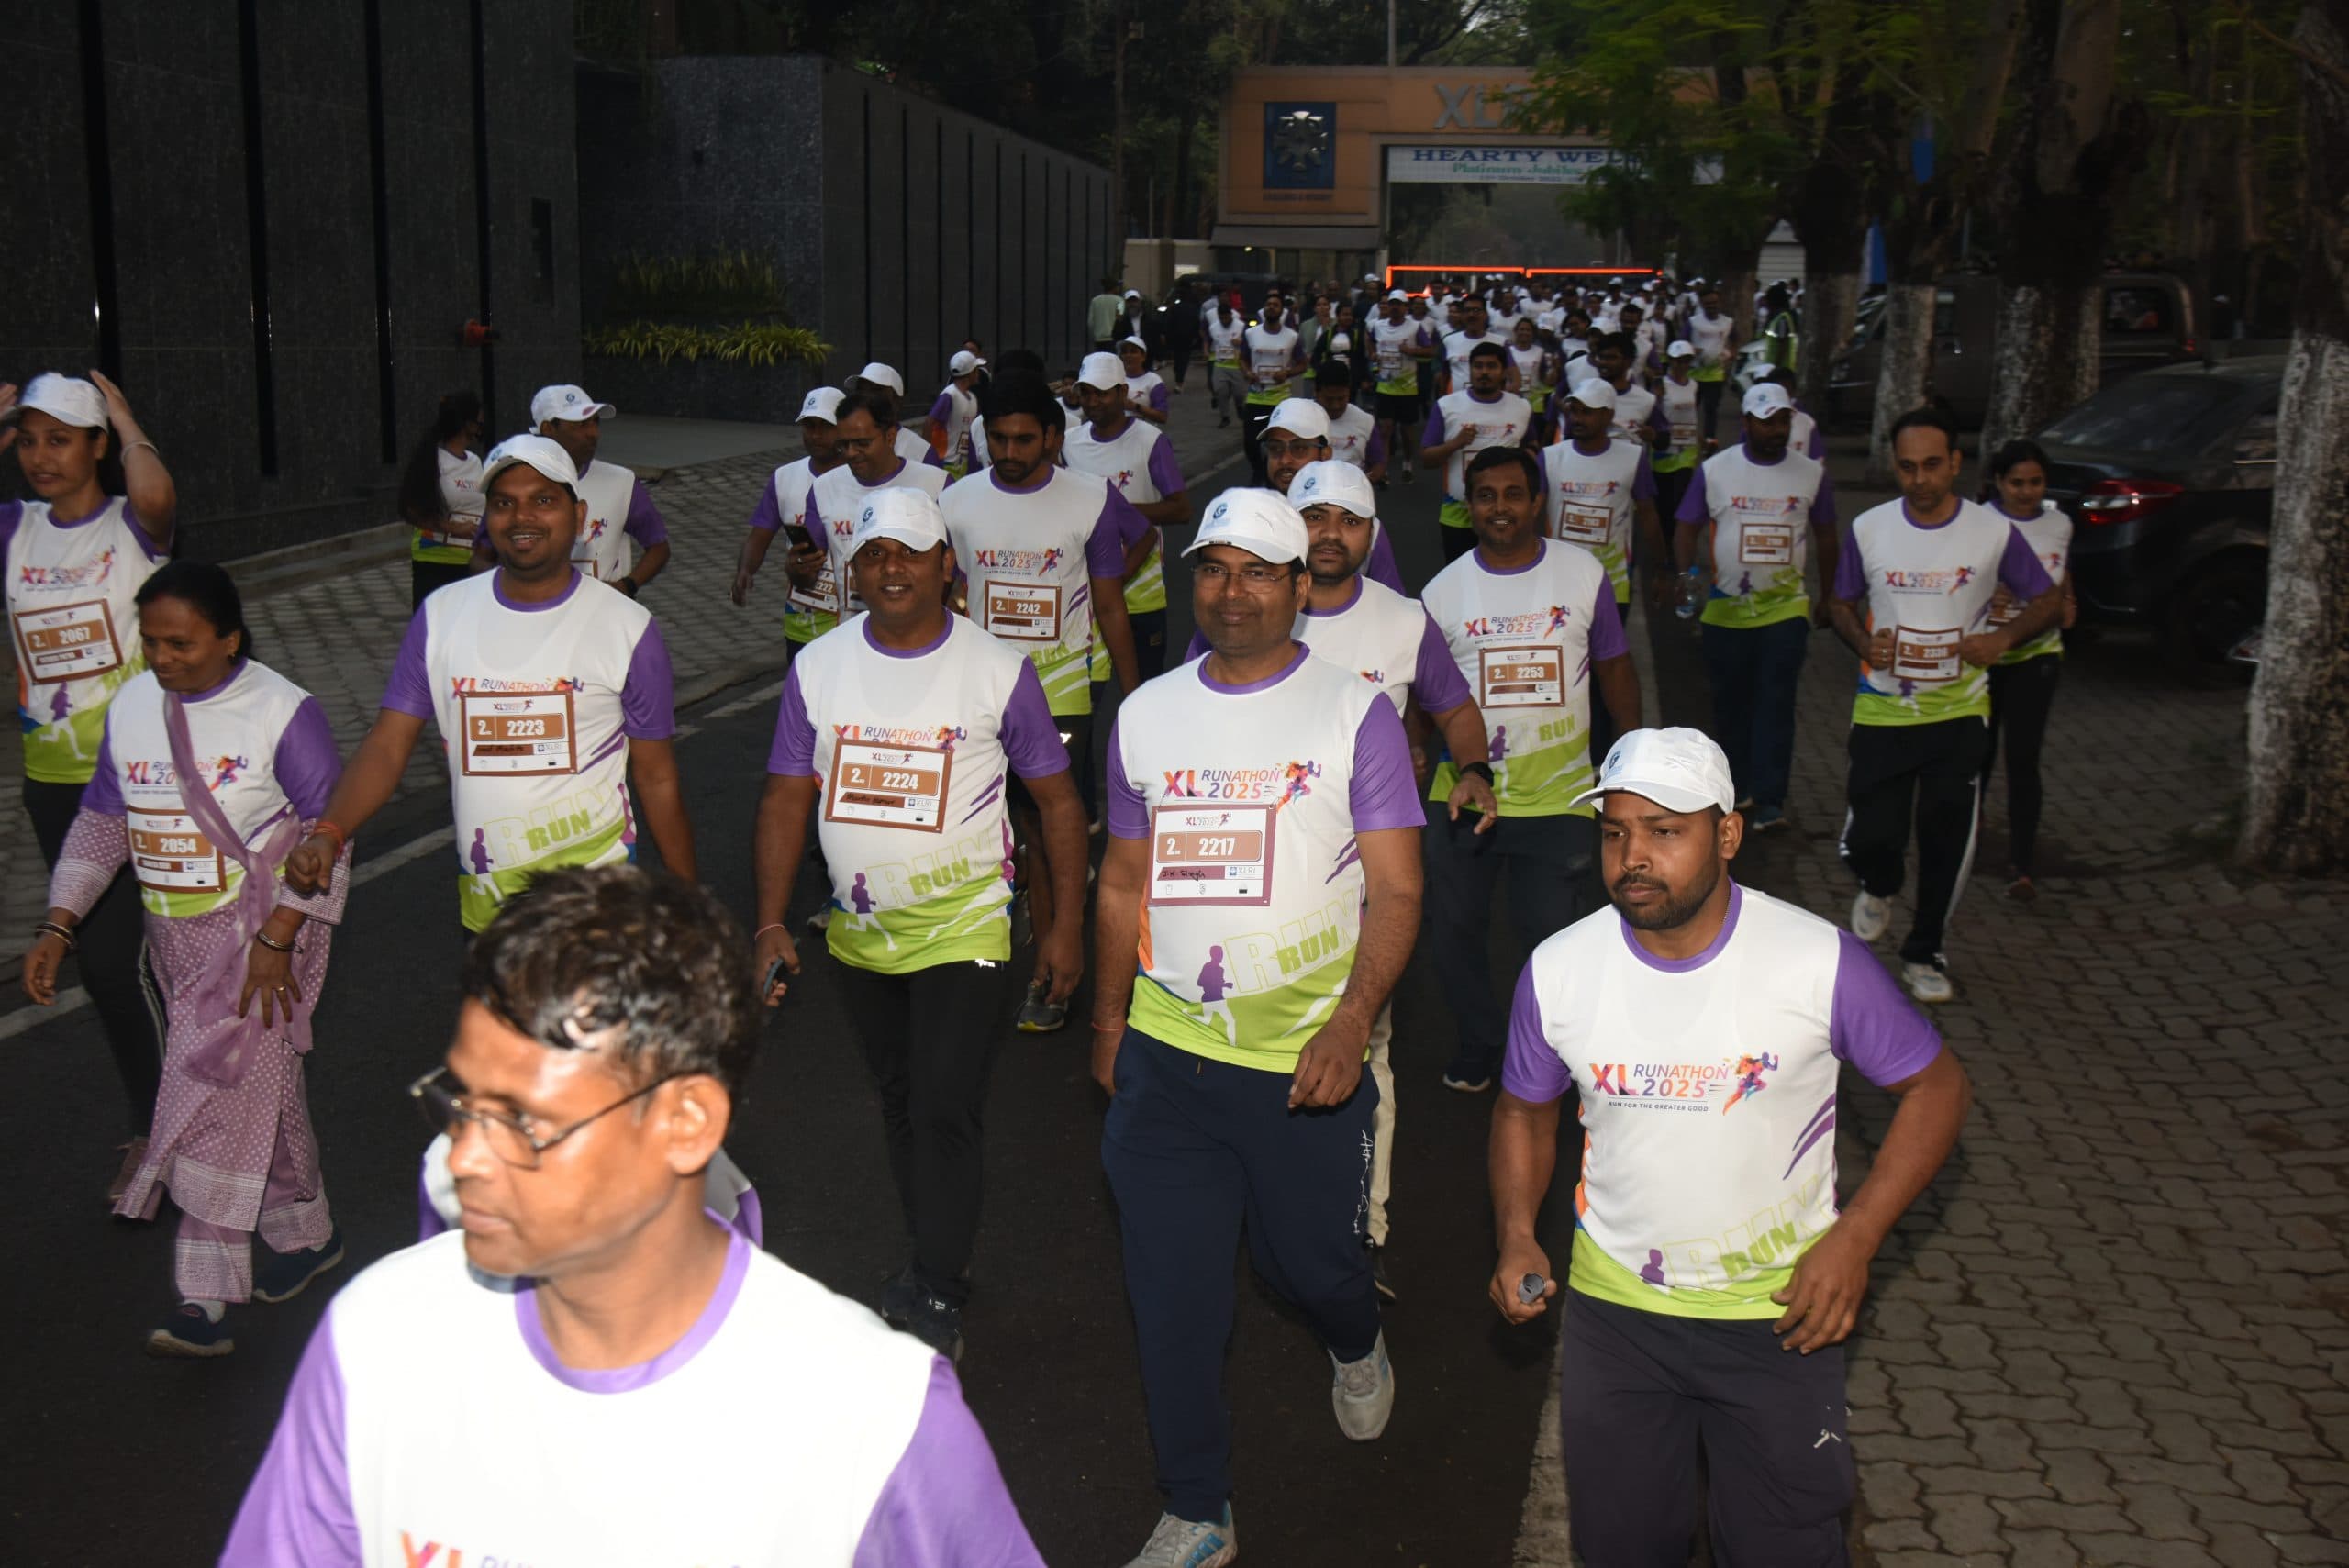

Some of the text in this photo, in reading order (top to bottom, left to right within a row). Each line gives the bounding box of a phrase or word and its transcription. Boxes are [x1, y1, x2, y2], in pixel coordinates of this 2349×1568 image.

[1413, 149, 1544, 162] HEARTY
[974, 550, 1043, 567] XL RUNATHON
[1001, 558, 1031, 569] 2025
[1885, 572, 1908, 587] XL
[1016, 602, 1041, 615] 2242
[1464, 613, 1546, 638] XL RUNATHON
[1497, 622, 1534, 634] 2025
[58, 627, 91, 645] 2067
[1493, 668, 1505, 679] 2.
[480, 678, 551, 693] RUNATHON
[477, 720, 545, 737] 2. 2223
[863, 726, 933, 742] RUNATHON
[1539, 712, 1575, 742] RUN
[127, 762, 153, 784] XL
[850, 767, 919, 790] 2. 2224
[1163, 769, 1280, 798] XL RUNATHON
[1208, 782, 1263, 800] 2025
[526, 808, 592, 852] RUN
[1186, 817, 1197, 827] XL
[135, 833, 197, 853] 2. 2054
[1166, 837, 1236, 856] 2. 2217
[909, 856, 971, 896] RUN
[1276, 924, 1339, 975] RUN
[1589, 1063, 1729, 1096] XL RUNATHON
[1642, 1078, 1707, 1098] 2025
[1720, 1220, 1798, 1280] RUN
